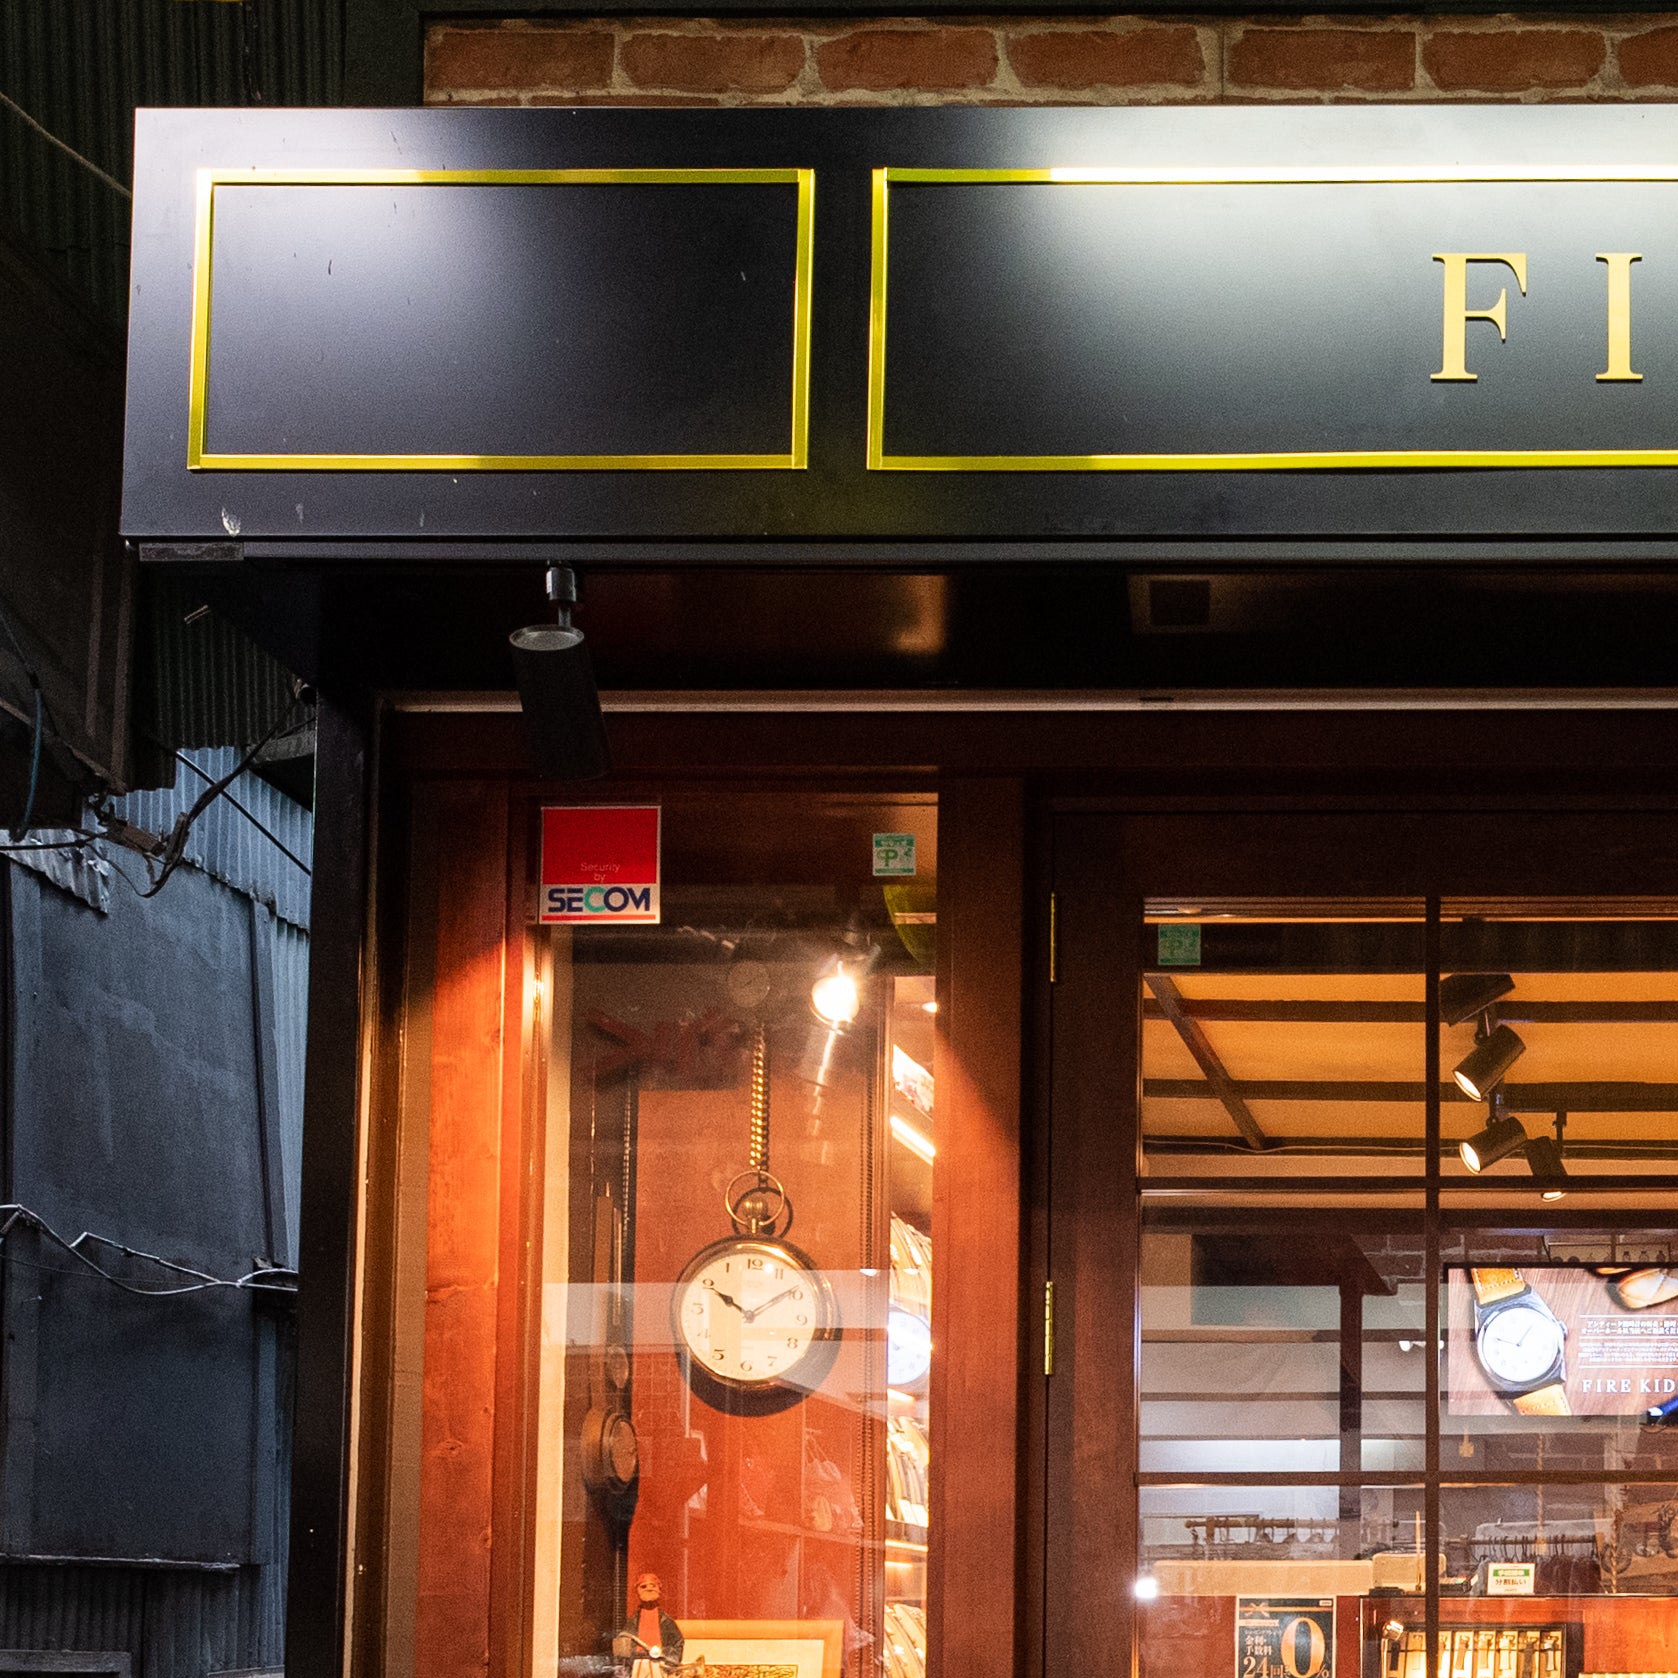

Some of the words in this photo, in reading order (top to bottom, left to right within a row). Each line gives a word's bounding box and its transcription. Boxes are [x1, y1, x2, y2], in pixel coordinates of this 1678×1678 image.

[580, 863, 621, 873] Security
[593, 873, 606, 883] by
[547, 886, 651, 913] SECOM
[1582, 1379, 1632, 1393] FIRE
